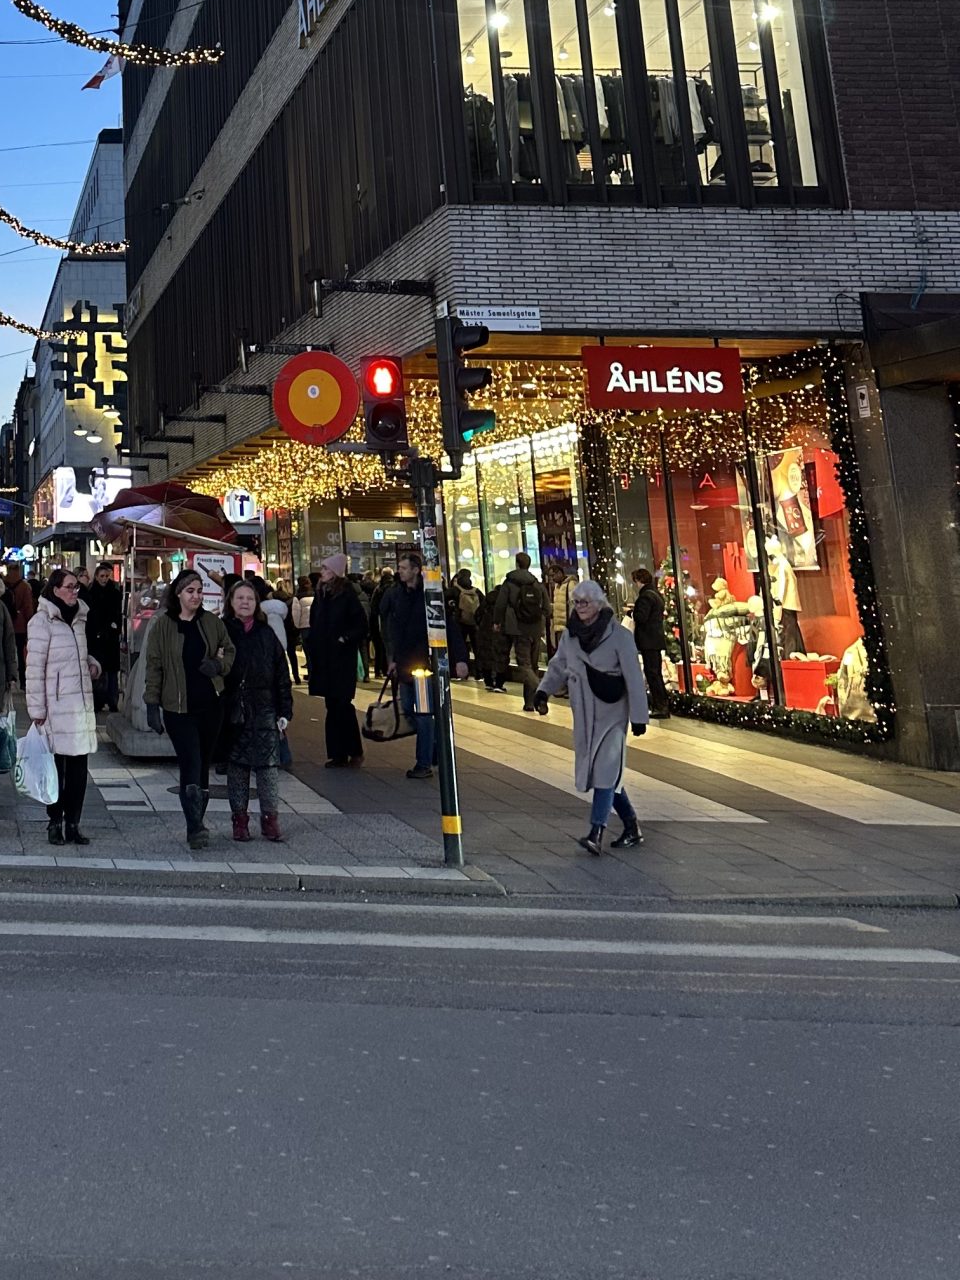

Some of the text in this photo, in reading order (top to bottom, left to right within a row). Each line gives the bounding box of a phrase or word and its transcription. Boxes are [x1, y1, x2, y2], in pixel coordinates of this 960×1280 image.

[460, 308, 536, 318] Mäster Samuelsgatan
[606, 362, 724, 394] ÅHLÉNS
